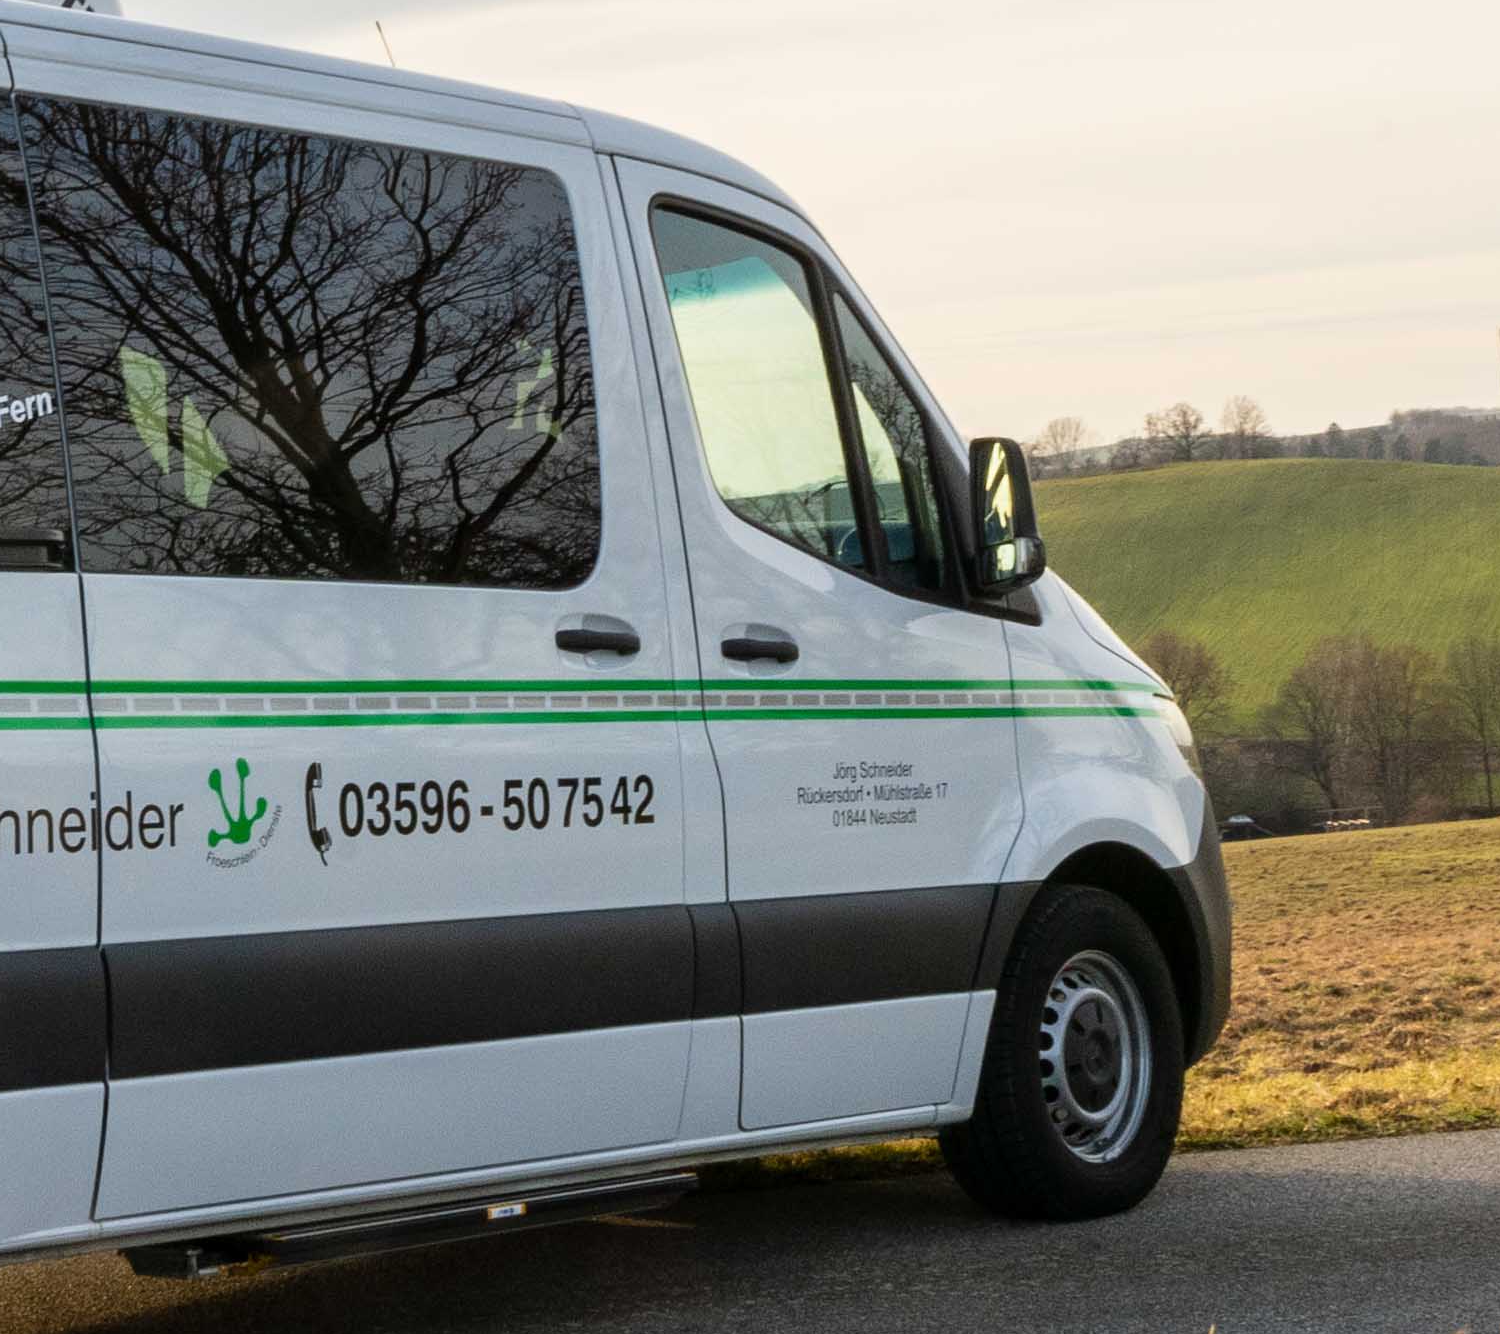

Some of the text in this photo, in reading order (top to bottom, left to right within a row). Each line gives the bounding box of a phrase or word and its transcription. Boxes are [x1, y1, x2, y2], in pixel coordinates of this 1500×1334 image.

[833, 761, 913, 783] Jörg Schneider
[797, 782, 948, 804] Rückersdorf Mühlstraße 17
[833, 807, 917, 827] 01844 Neustadt
